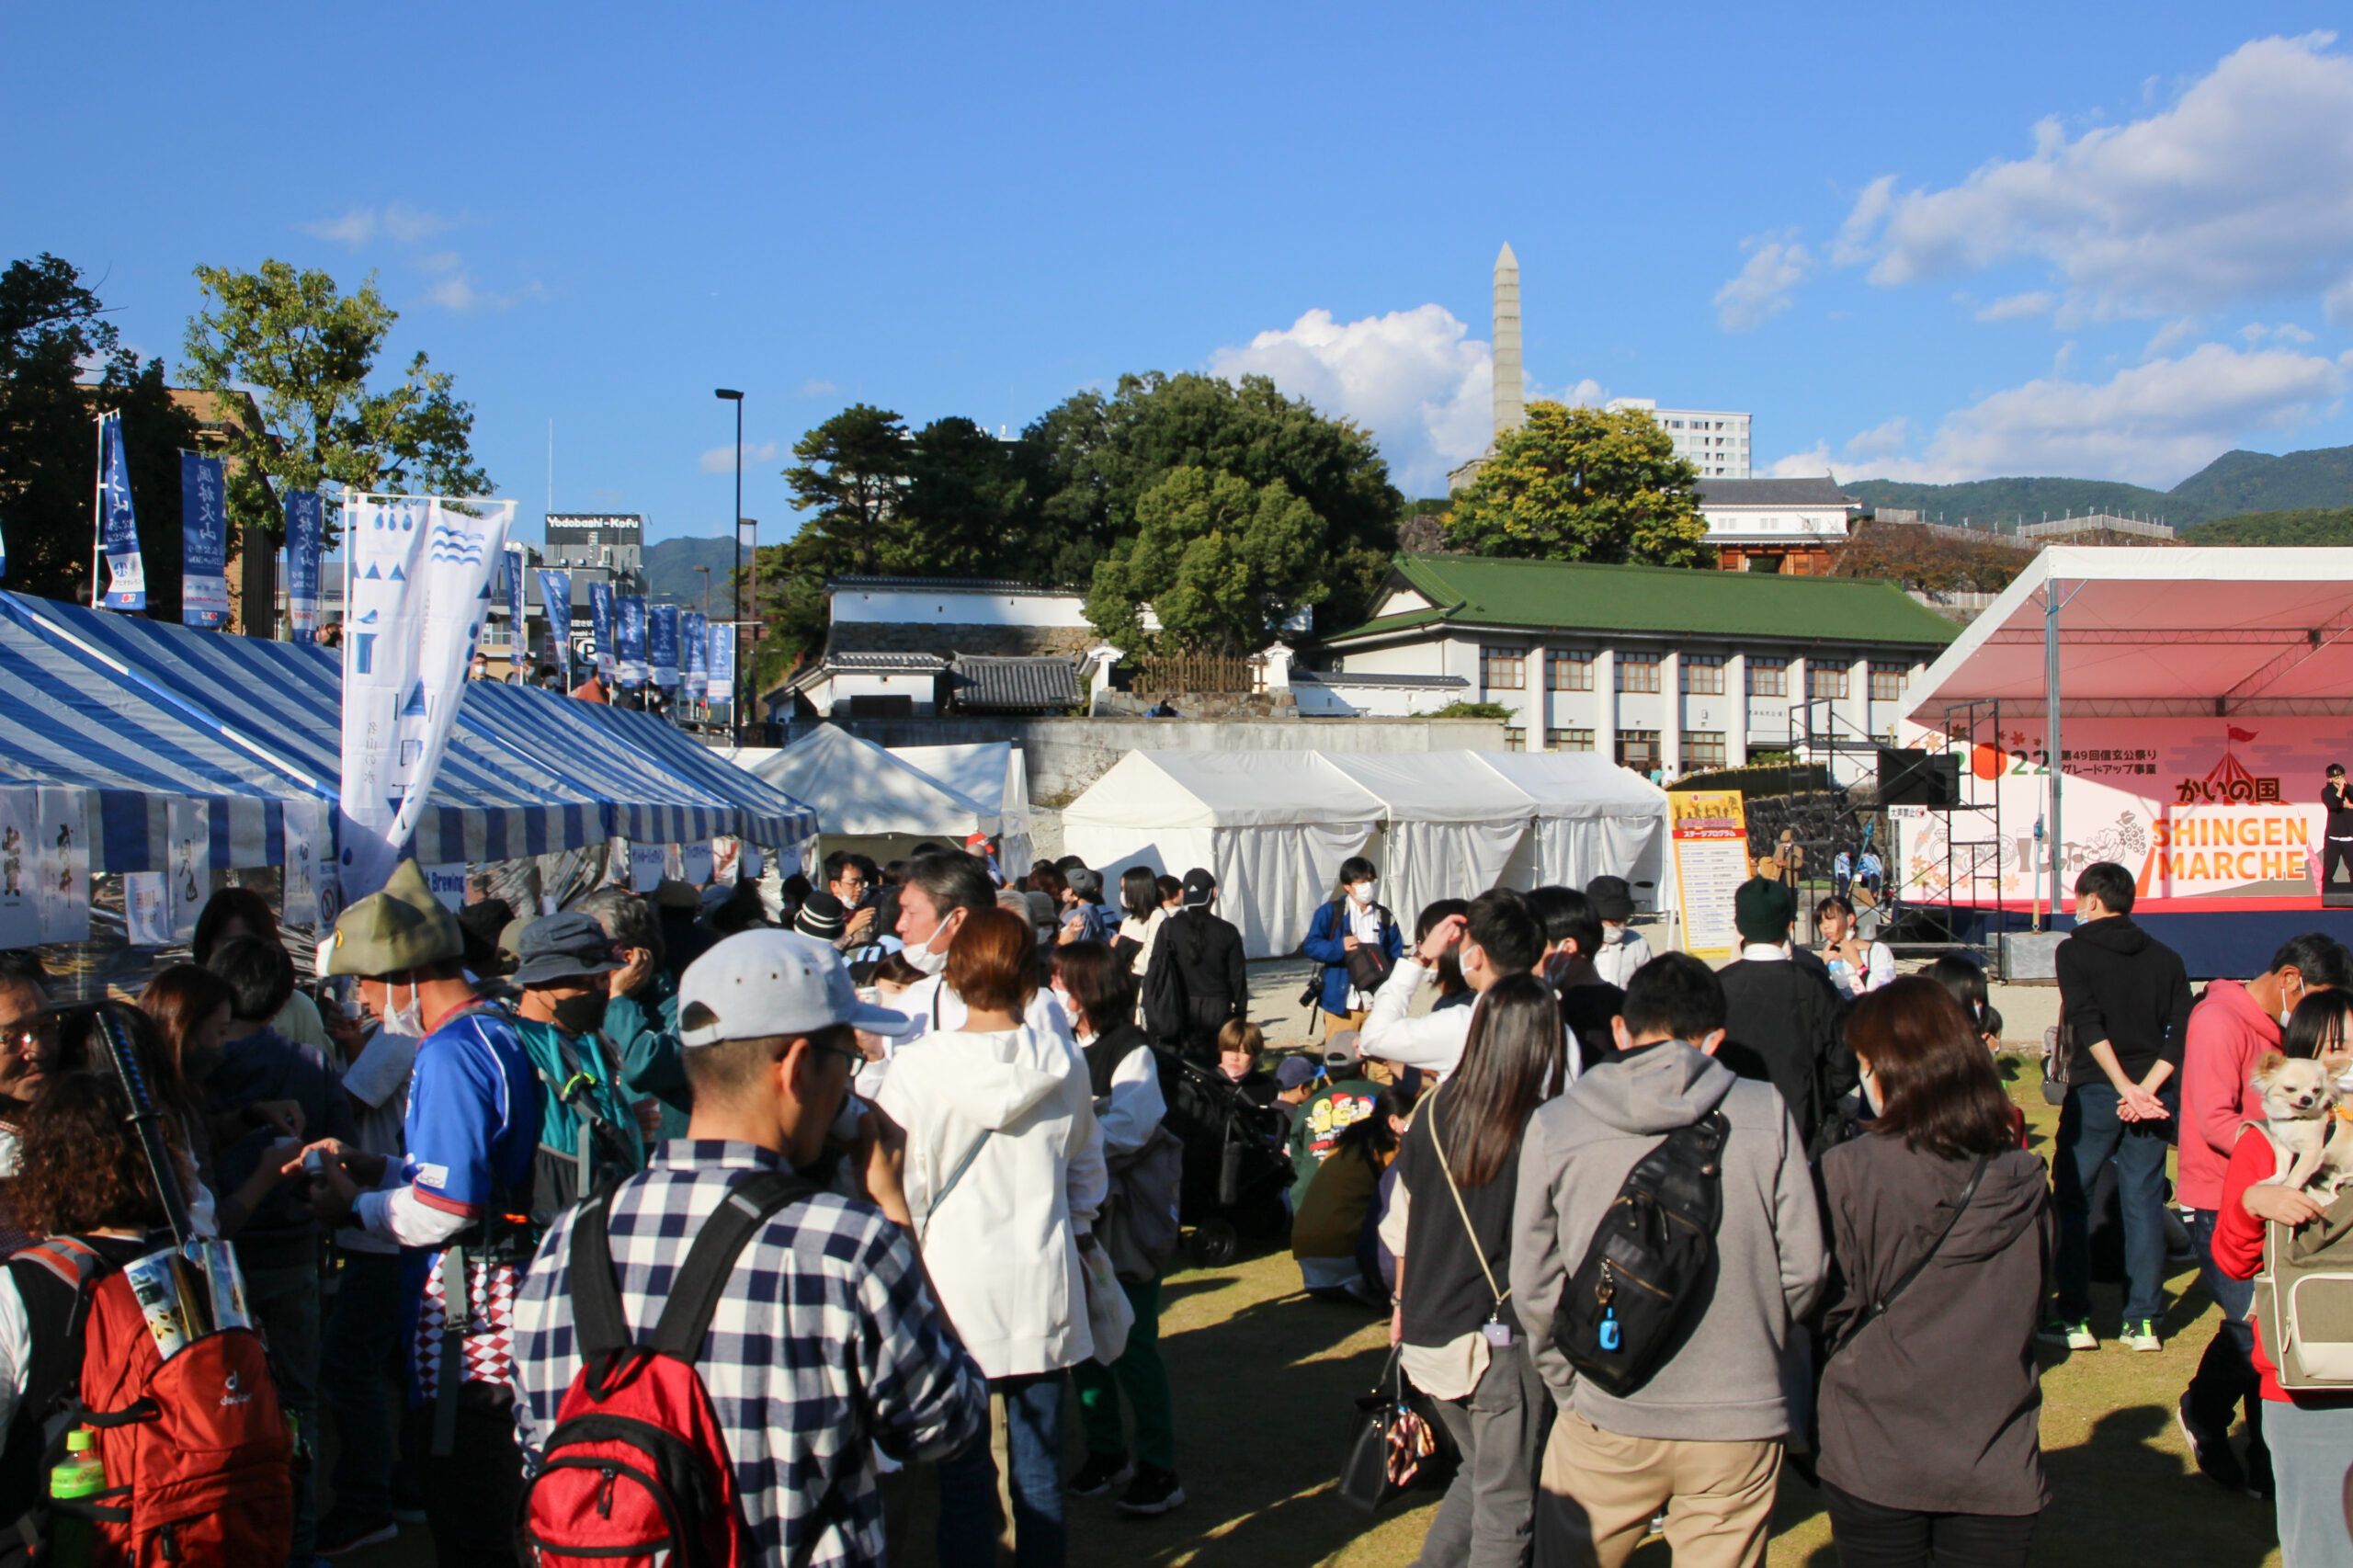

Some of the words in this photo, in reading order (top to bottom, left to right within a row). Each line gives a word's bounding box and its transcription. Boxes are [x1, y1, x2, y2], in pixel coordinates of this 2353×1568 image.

[2061, 749, 2157, 761] 第49回信玄公祭り
[2062, 764, 2157, 775] グレードアップ事業
[2176, 778, 2280, 803] かいの国
[1683, 829, 1736, 838] ステージプログラム
[2152, 817, 2309, 847] SHINGEN
[2158, 851, 2307, 881] MARCHE
